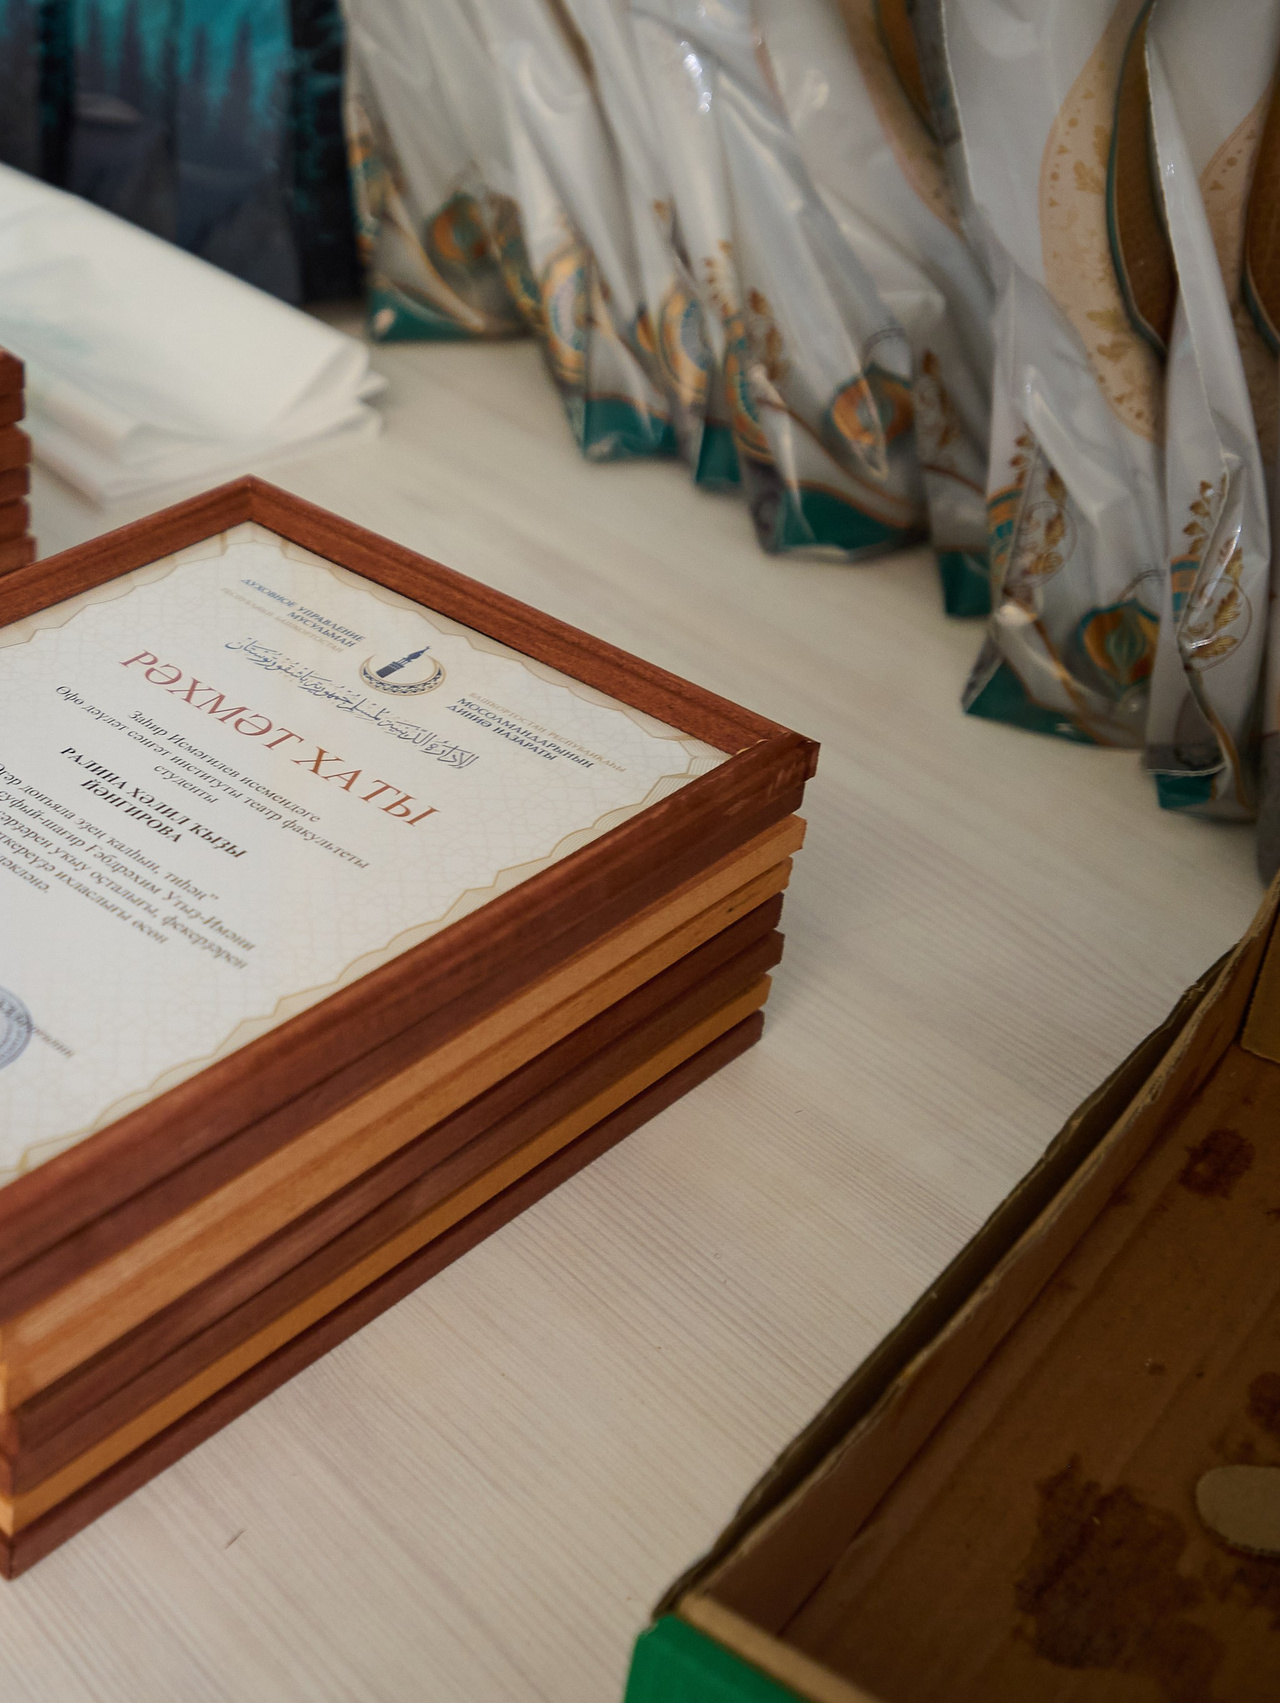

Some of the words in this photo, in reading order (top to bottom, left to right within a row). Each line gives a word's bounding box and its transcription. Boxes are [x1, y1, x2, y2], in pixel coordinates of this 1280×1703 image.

[240, 578, 297, 607] ДУХОВНОЕ
[296, 606, 366, 642] УПРАВЛЕНИЕ
[289, 611, 356, 648] МУСУЛЬМАН
[120, 650, 304, 749] РӘХМӘТ
[291, 746, 438, 826] ХАТЫ
[129, 710, 168, 736] Заһир
[166, 733, 240, 778] Исмәгилев
[238, 776, 320, 822] исемендәге
[17, 785, 76, 819] донъяла
[55, 685, 84, 705] Өфө
[80, 704, 127, 731] дәүләт
[169, 755, 243, 798] институты
[243, 797, 283, 820] театр
[281, 819, 369, 869] факультеты
[59, 747, 127, 790] РАЛИНА
[131, 787, 190, 825] ХӘЛИЛ
[188, 824, 247, 858] ҠЫҘЫ
[153, 765, 218, 804] студенты
[80, 779, 181, 842] ЙӘНГИРОВА
